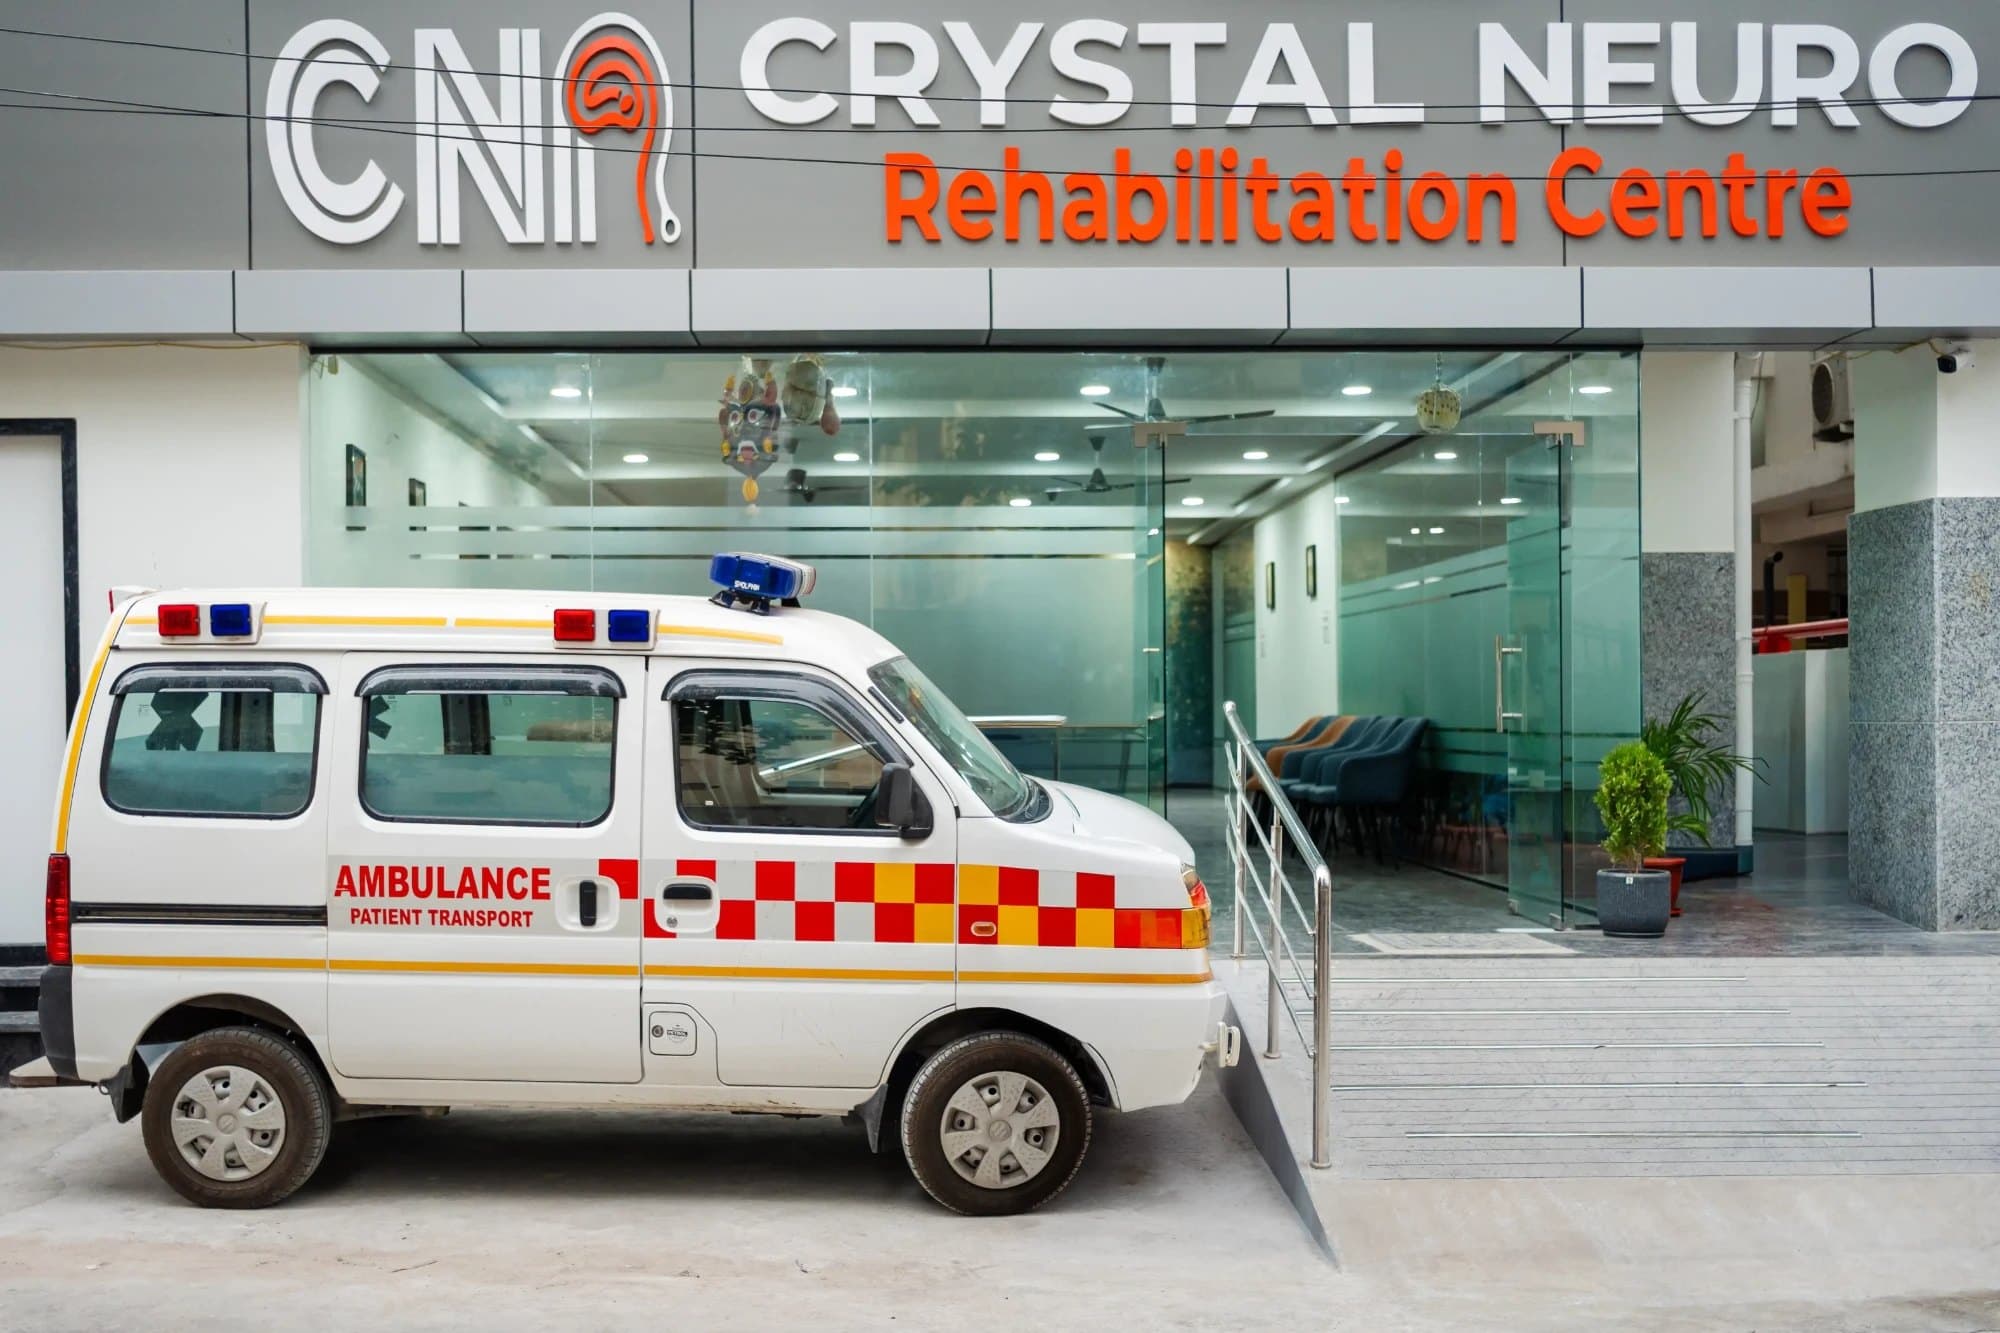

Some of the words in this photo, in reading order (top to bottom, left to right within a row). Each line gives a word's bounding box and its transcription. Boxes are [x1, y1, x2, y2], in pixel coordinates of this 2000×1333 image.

[740, 17, 1425, 126] CRYSTAL
[1479, 22, 1979, 128] NEURO
[885, 147, 1517, 242] Rehabilitation
[1546, 147, 1852, 238] Centre
[334, 865, 551, 900] AMBULANCE
[350, 908, 422, 926] PATIENT
[428, 909, 533, 928] TRANSPORT
